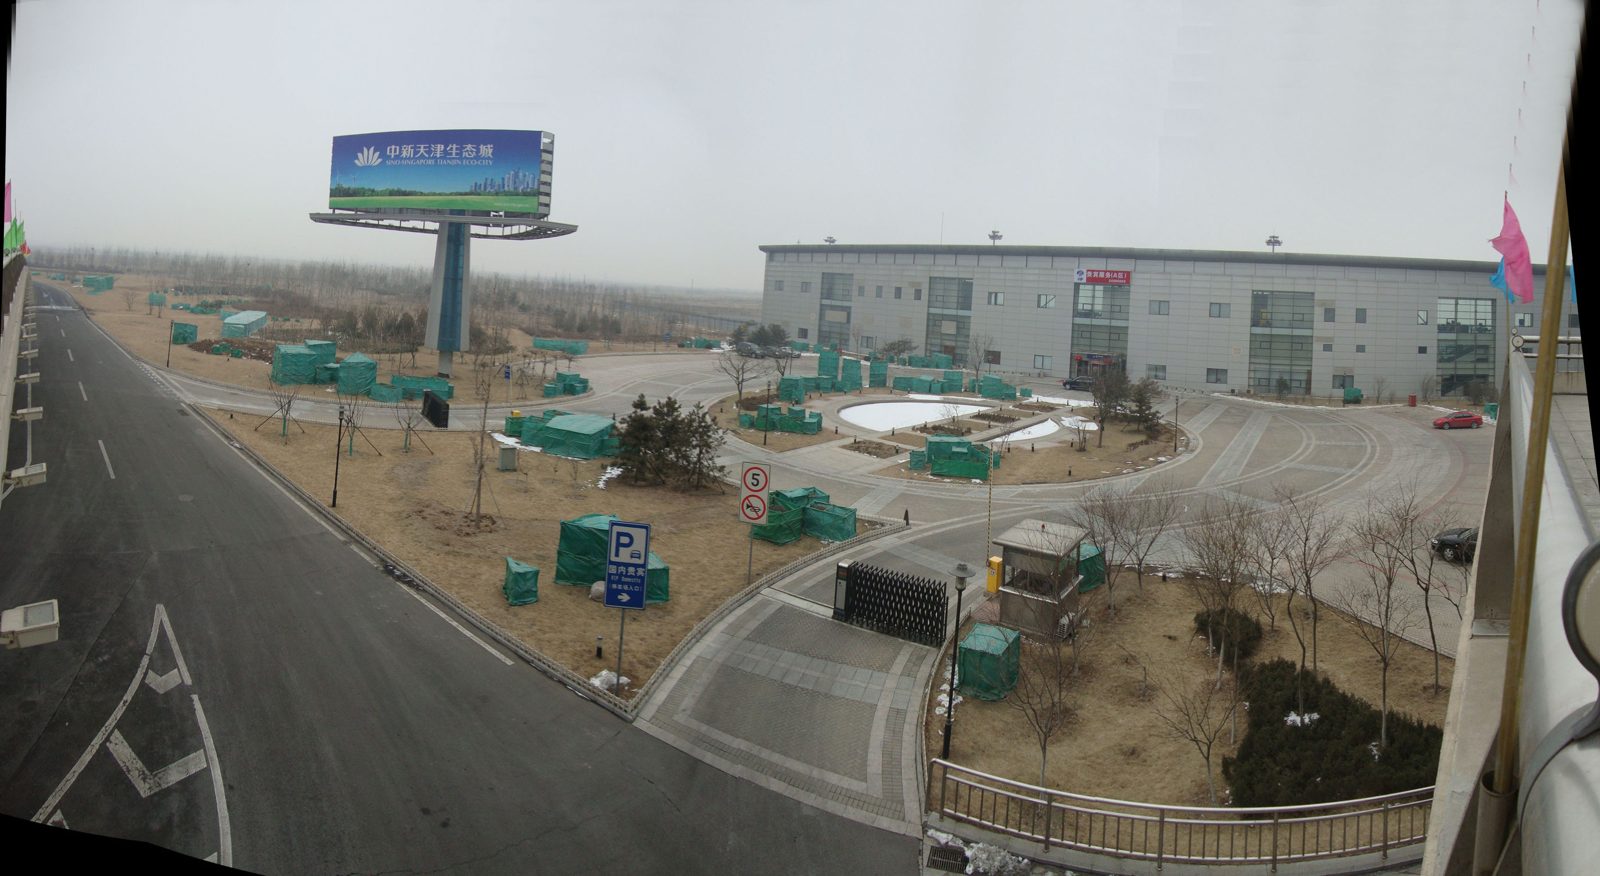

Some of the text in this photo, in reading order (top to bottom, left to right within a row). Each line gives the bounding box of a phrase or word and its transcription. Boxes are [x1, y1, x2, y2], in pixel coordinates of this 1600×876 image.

[386, 143, 494, 158] 中新天津生态城
[751, 473, 760, 487] 5
[614, 531, 634, 558] P
[608, 564, 646, 577] 国内贵宾
